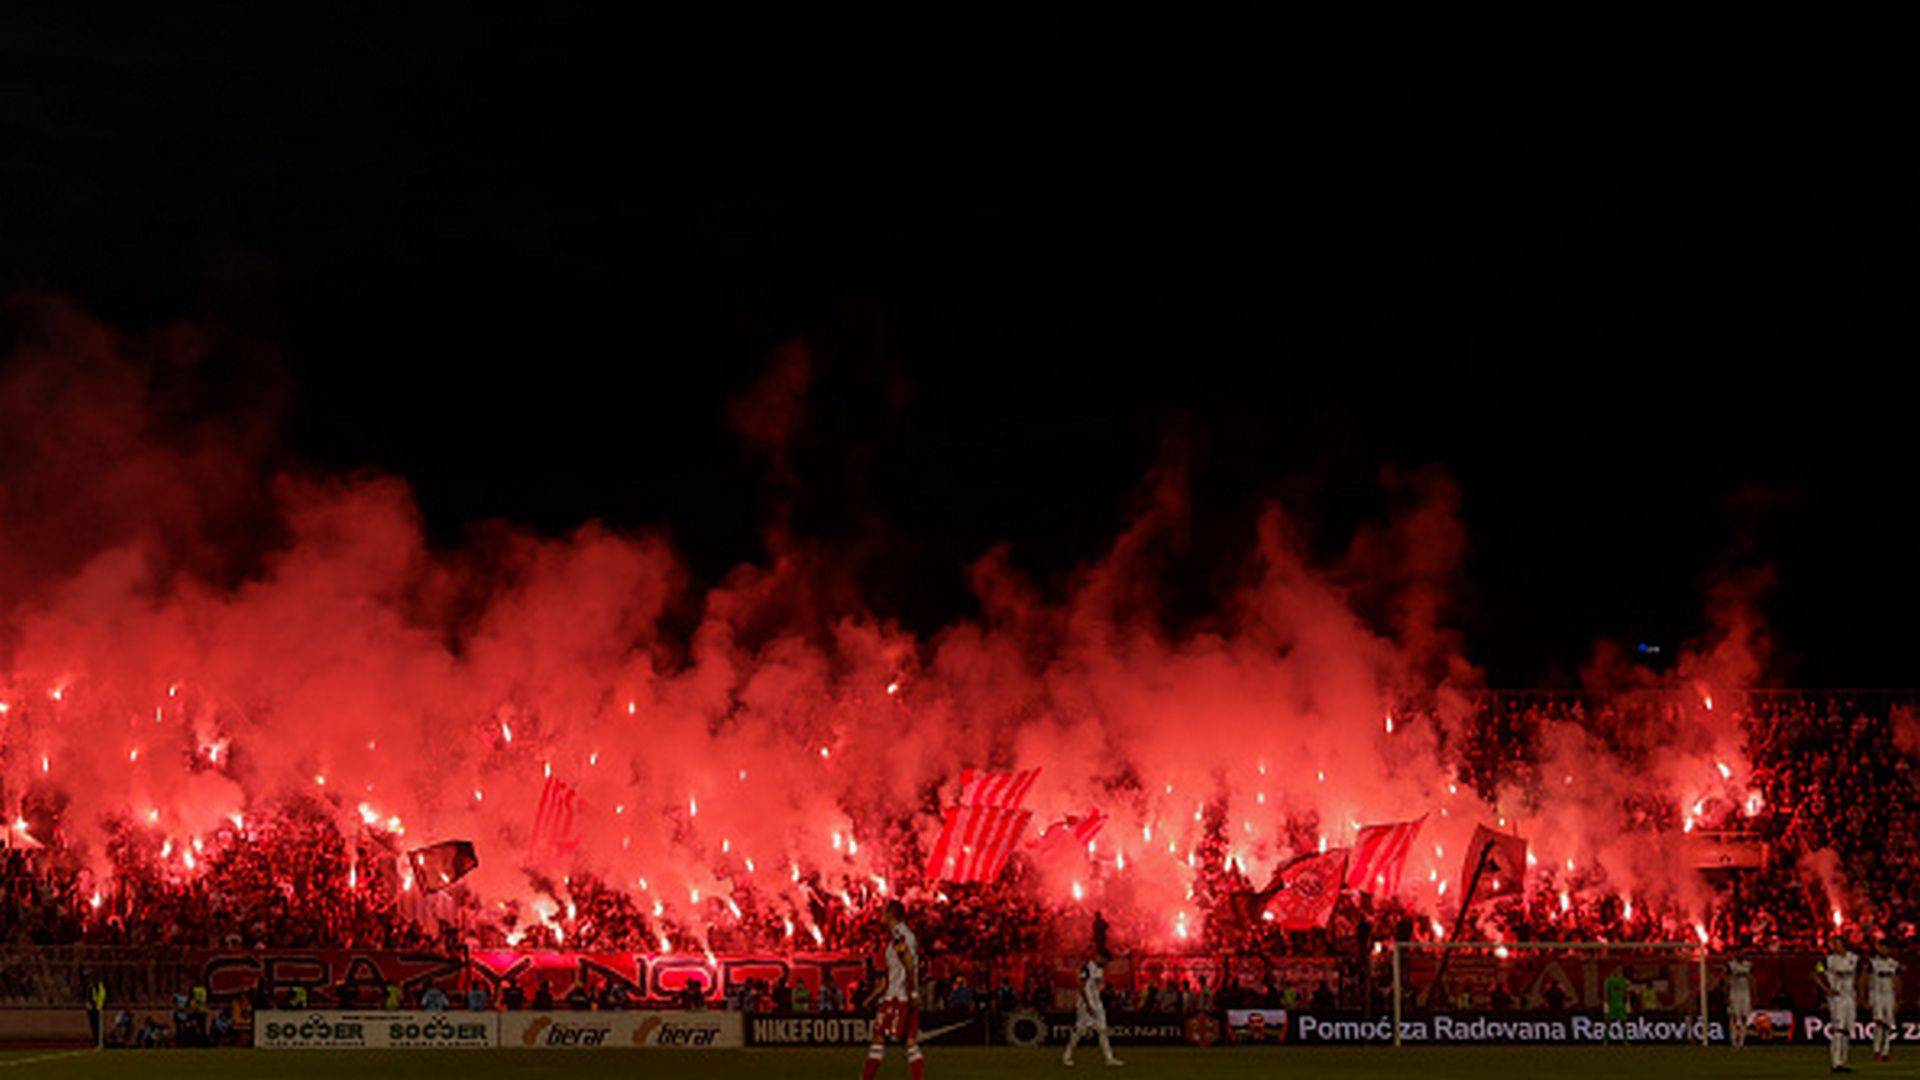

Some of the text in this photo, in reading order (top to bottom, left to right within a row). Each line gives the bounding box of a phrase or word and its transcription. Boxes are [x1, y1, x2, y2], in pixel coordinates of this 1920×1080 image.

[201, 953, 533, 1007] CRAZY
[265, 1022, 488, 1040] SOCCER SOCCER
[1298, 1014, 1392, 1041] Pomoć
[1399, 1021, 1427, 1041] za
[1433, 1014, 1566, 1041] Radovana
